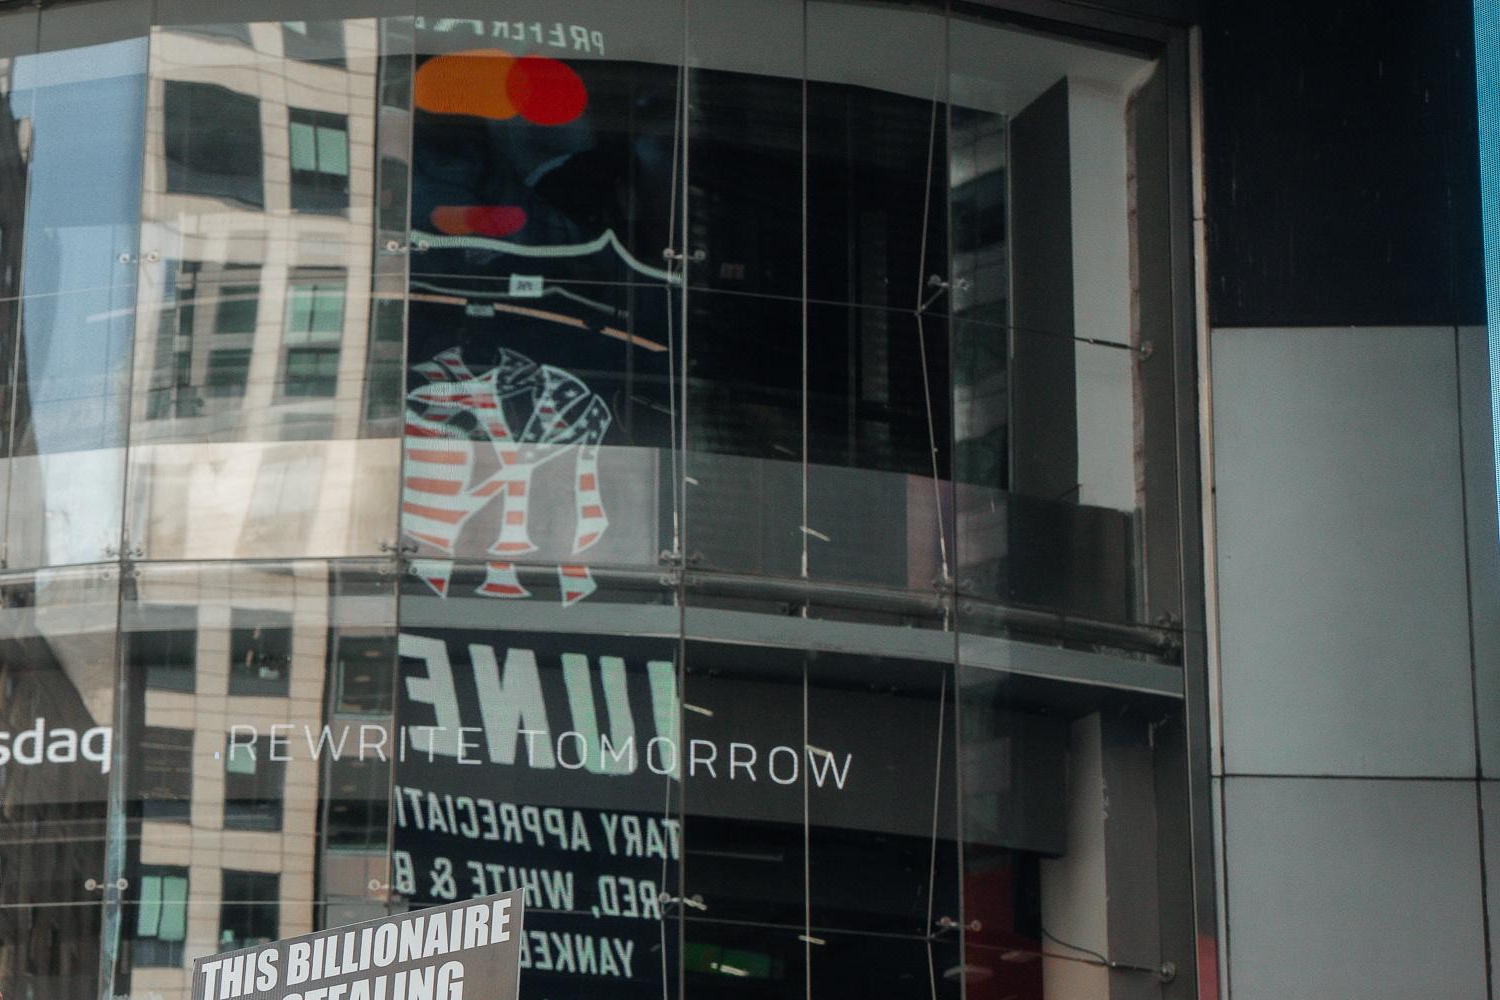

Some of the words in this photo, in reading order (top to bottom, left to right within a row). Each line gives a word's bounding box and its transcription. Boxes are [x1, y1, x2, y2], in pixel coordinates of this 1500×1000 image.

[230, 724, 483, 765] REWRITE
[517, 729, 853, 789] TOMORROW
[286, 898, 512, 986] BILLIONAIRE
